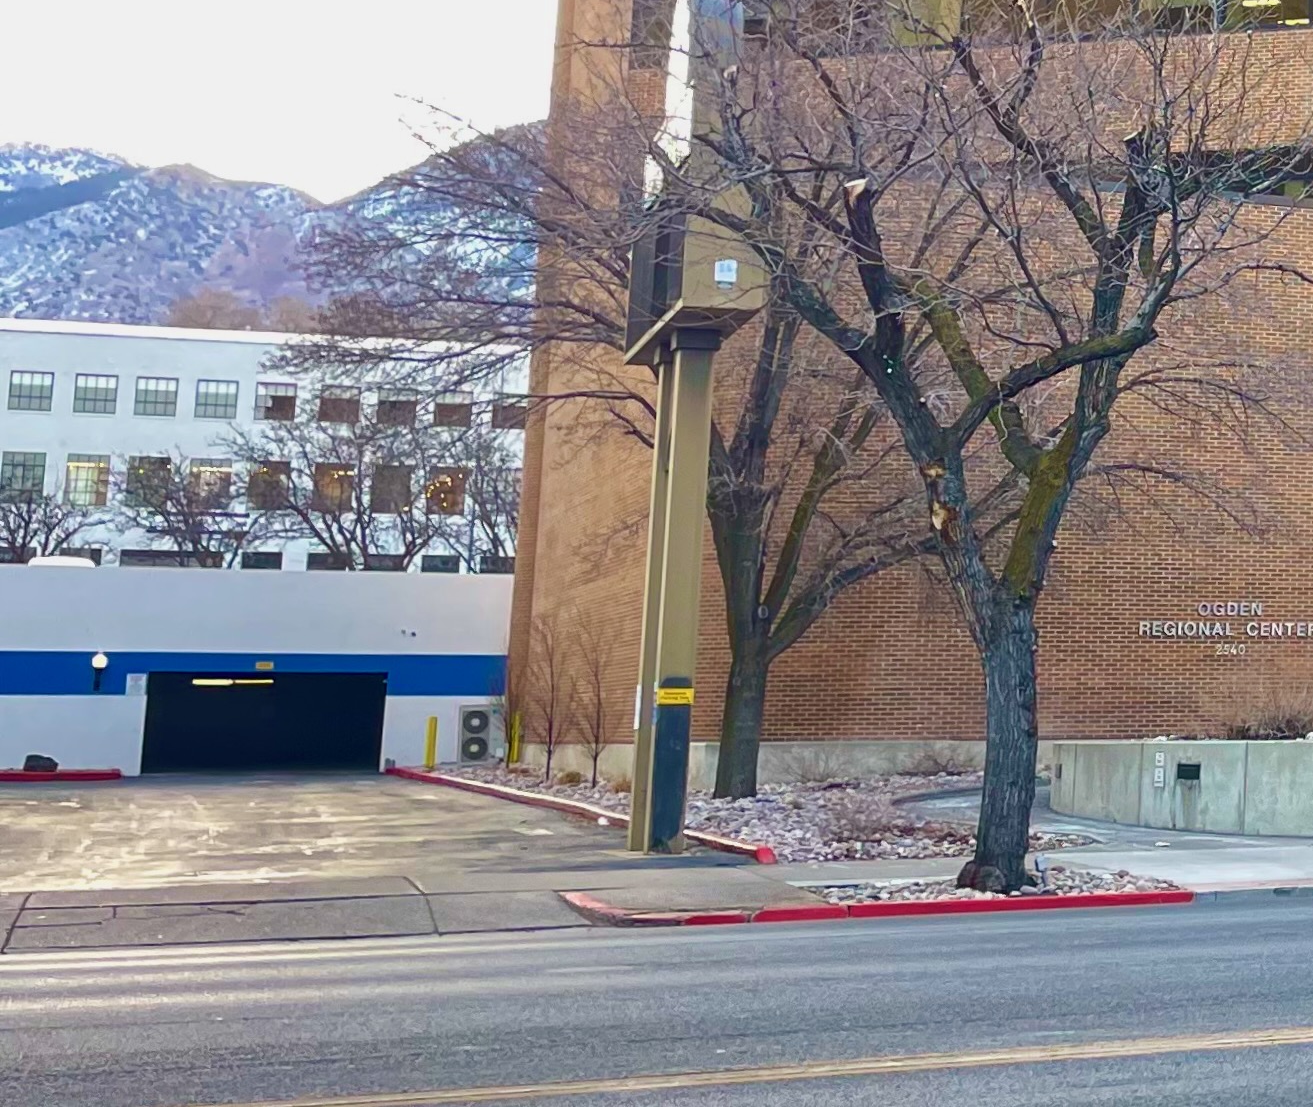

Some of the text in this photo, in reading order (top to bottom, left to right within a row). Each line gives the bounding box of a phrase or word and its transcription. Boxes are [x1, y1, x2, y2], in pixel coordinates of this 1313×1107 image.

[1197, 602, 1263, 617] OGDEN
[1138, 621, 1235, 637] REGIONAL
[1215, 644, 1246, 656] 2540
